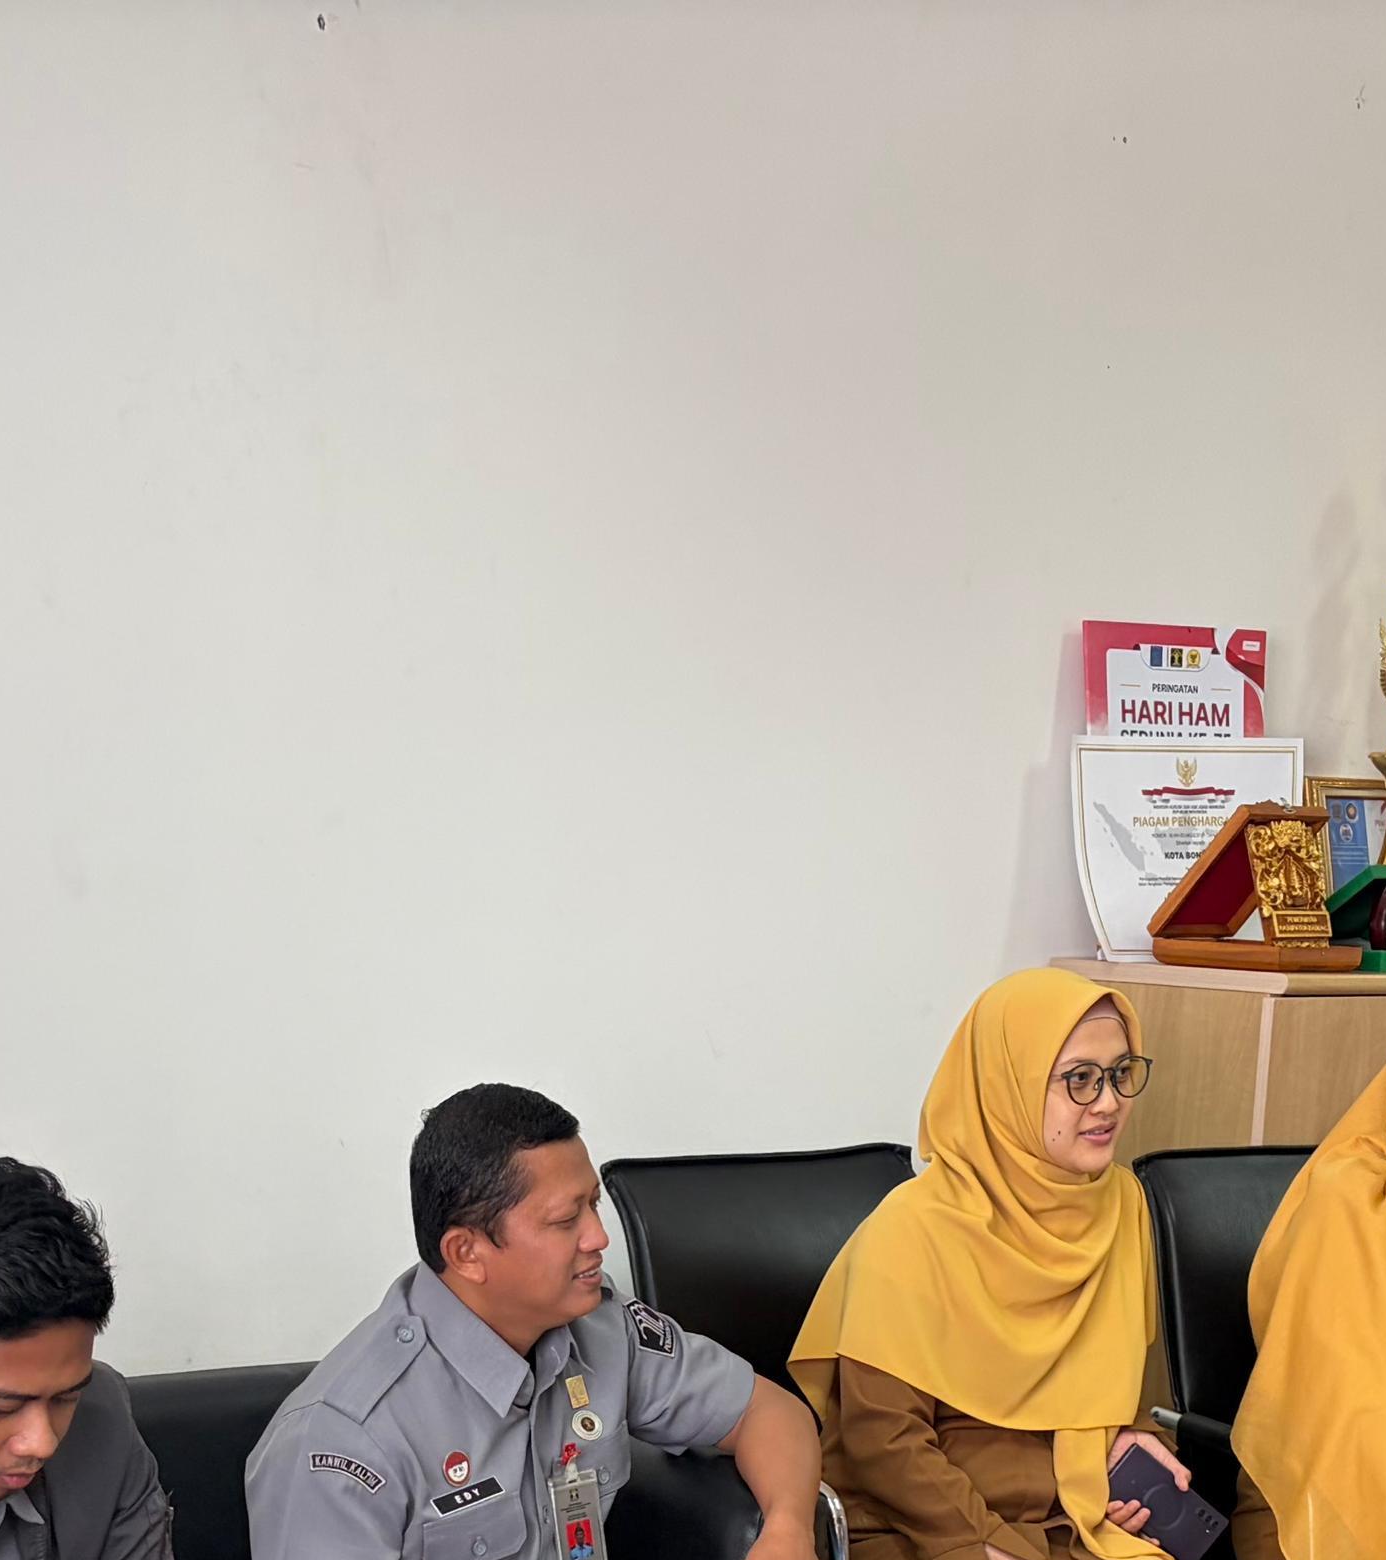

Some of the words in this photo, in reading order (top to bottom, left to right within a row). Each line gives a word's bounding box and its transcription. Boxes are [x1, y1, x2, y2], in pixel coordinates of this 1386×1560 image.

[1152, 683, 1198, 694] PERINGATAN
[1120, 699, 1173, 725] HARI
[1178, 701, 1230, 727] HAM
[1133, 816, 1169, 827] PIAGAM
[1171, 816, 1231, 828] PENGHARG
[1164, 851, 1184, 860] KOTA
[1186, 851, 1205, 859] BON
[315, 1456, 348, 1470] KANWIL
[454, 1488, 480, 1504] EDY
